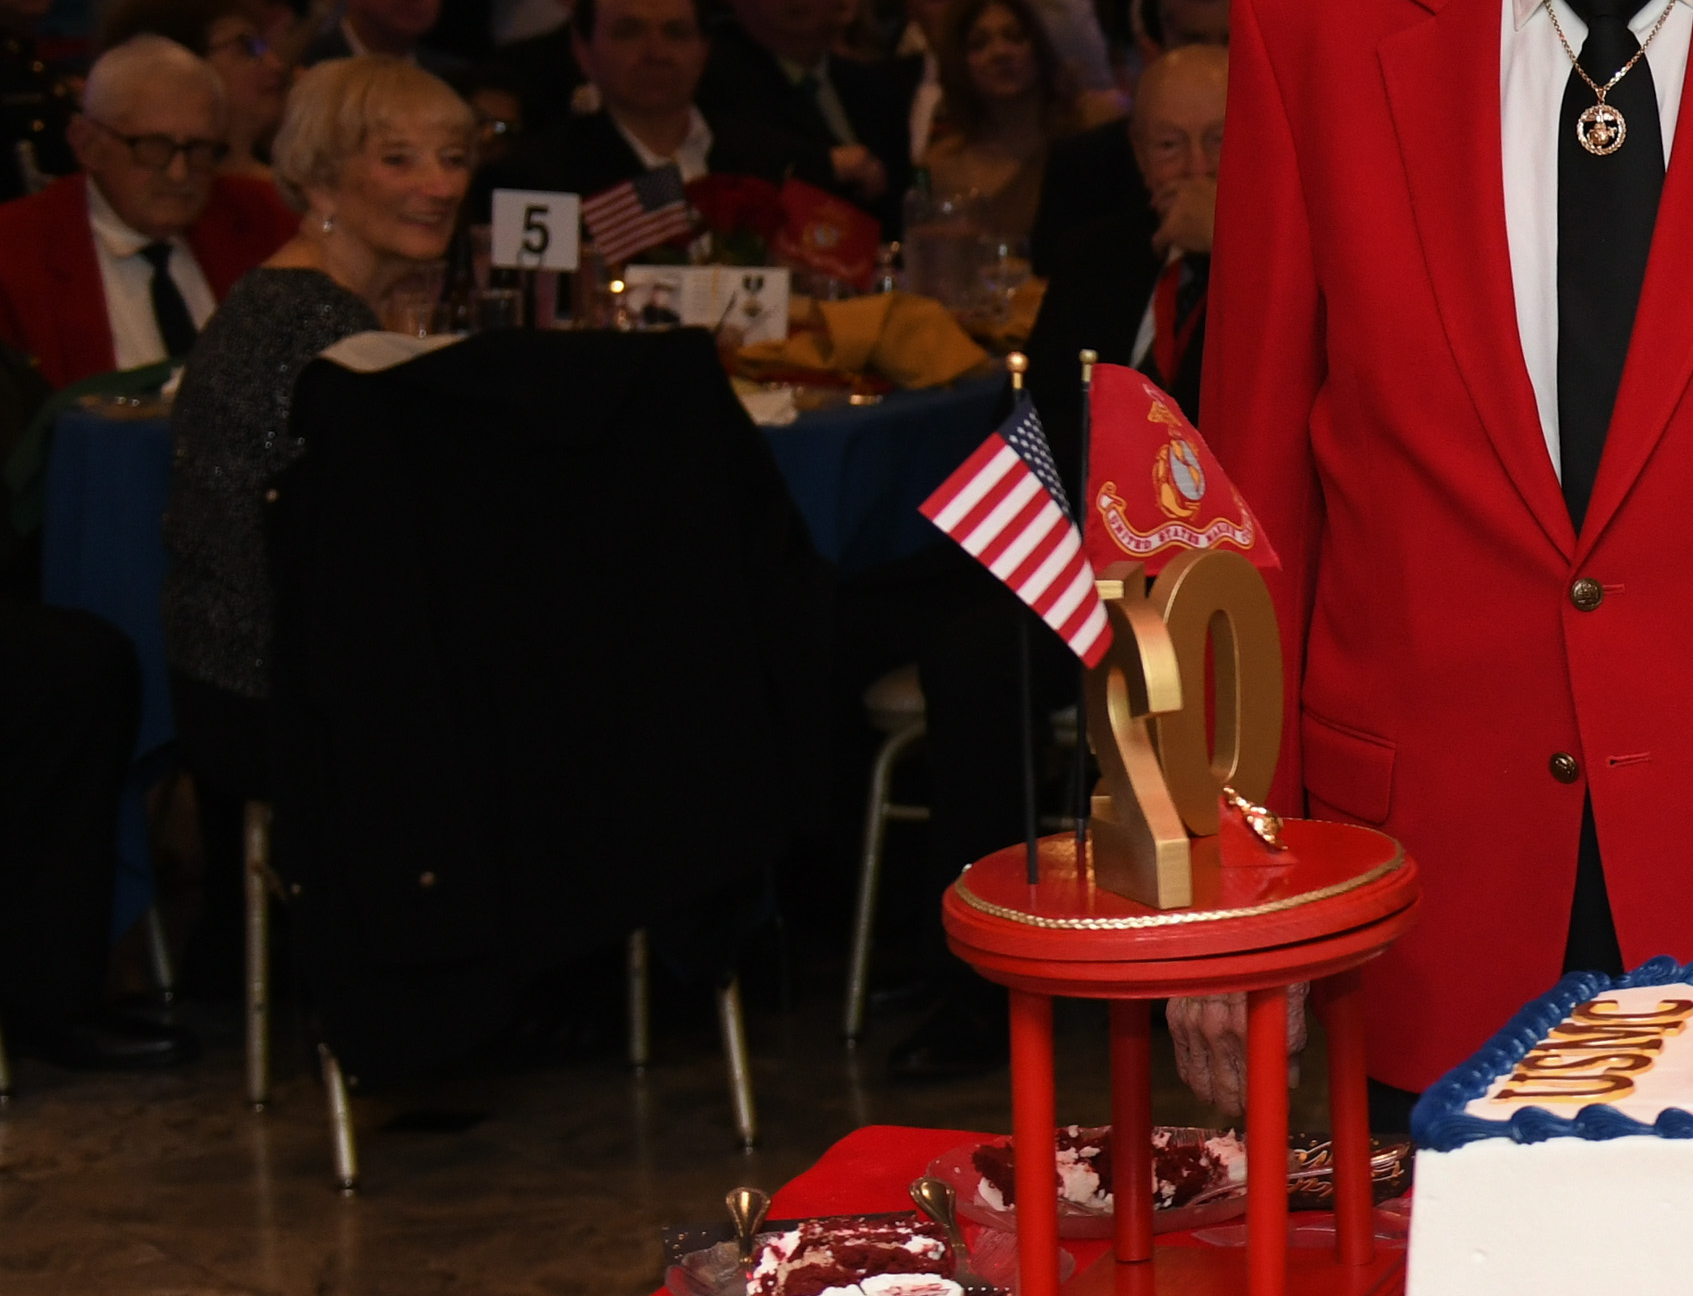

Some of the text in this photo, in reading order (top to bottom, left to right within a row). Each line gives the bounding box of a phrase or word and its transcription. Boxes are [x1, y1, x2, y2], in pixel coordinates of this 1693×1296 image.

[521, 205, 550, 254] 5
[1109, 515, 1152, 550] UNITED
[1158, 527, 1201, 545] STATES
